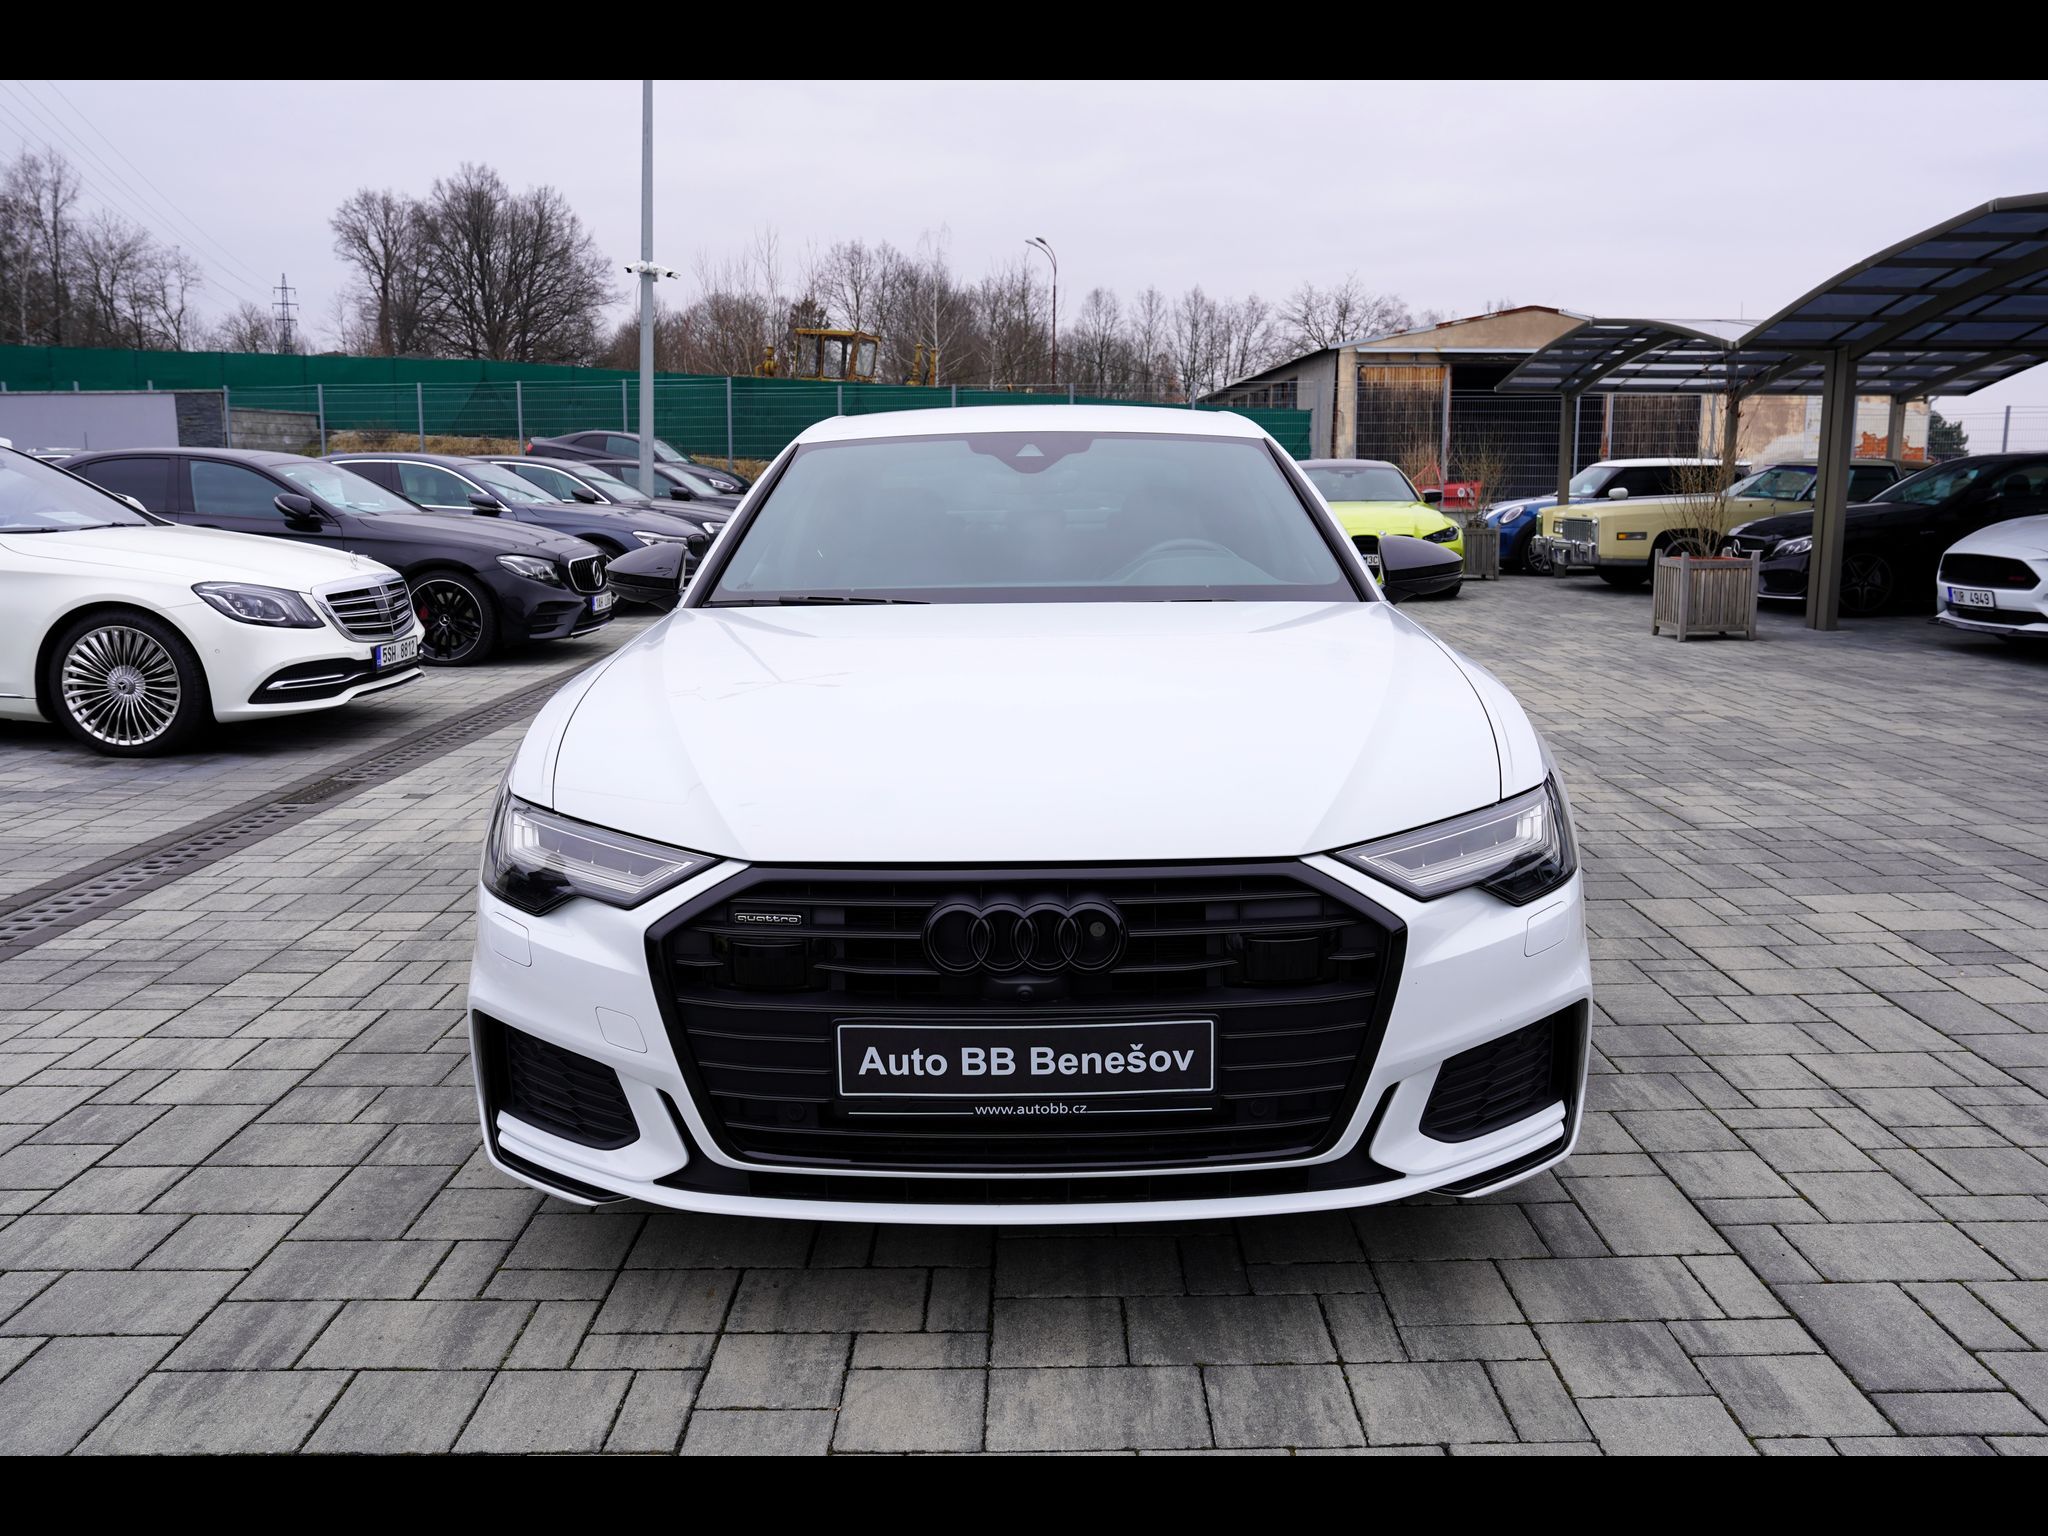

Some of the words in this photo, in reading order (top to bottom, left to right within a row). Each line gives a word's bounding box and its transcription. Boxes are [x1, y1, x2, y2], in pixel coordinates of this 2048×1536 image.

[1970, 592, 1990, 605] 4949
[383, 645, 396, 663] 5SH
[401, 640, 415, 658] 8812
[737, 915, 798, 923] quattro
[858, 1046, 948, 1076] Auto
[961, 1046, 1016, 1076] BB
[1030, 1043, 1195, 1075] Benešov
[974, 1102, 1088, 1116] www.autobb.cz
